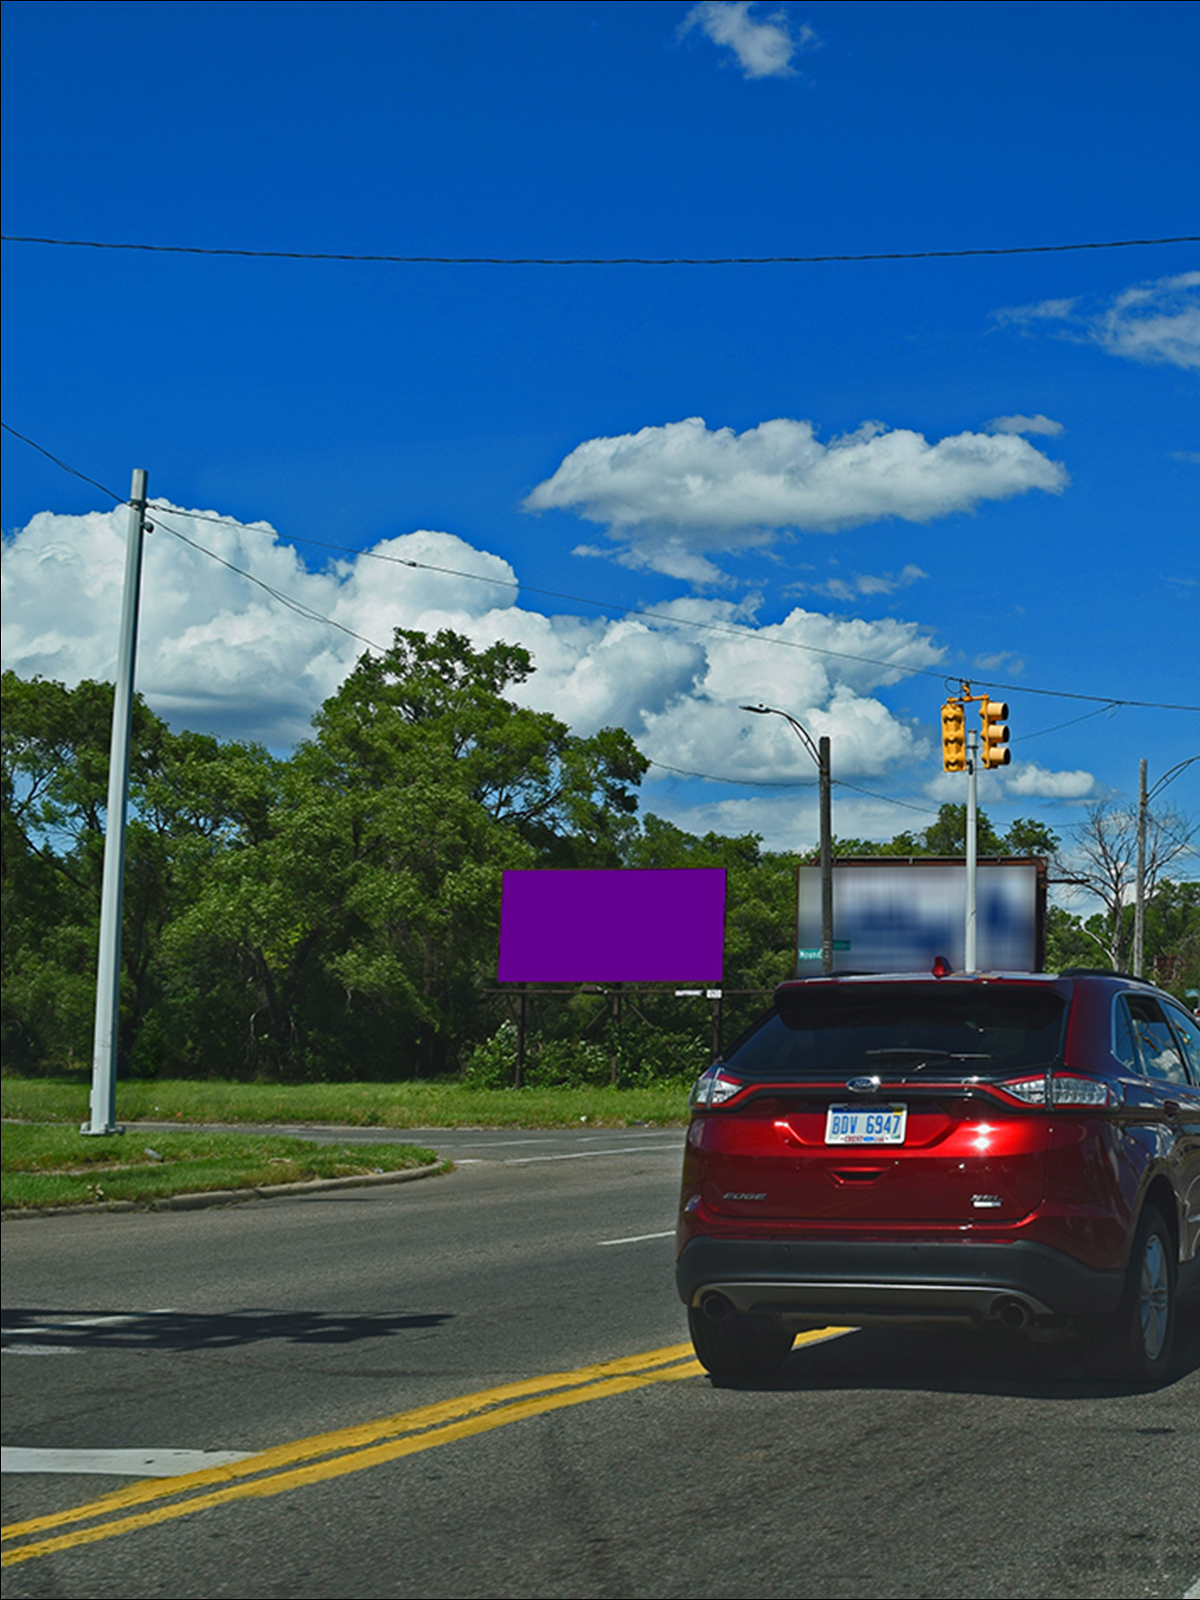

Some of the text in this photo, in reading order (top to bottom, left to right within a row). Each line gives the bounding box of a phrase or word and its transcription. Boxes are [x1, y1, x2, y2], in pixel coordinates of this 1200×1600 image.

[832, 1115, 901, 1135] BDV 6947
[723, 1192, 767, 1200] EDGE
